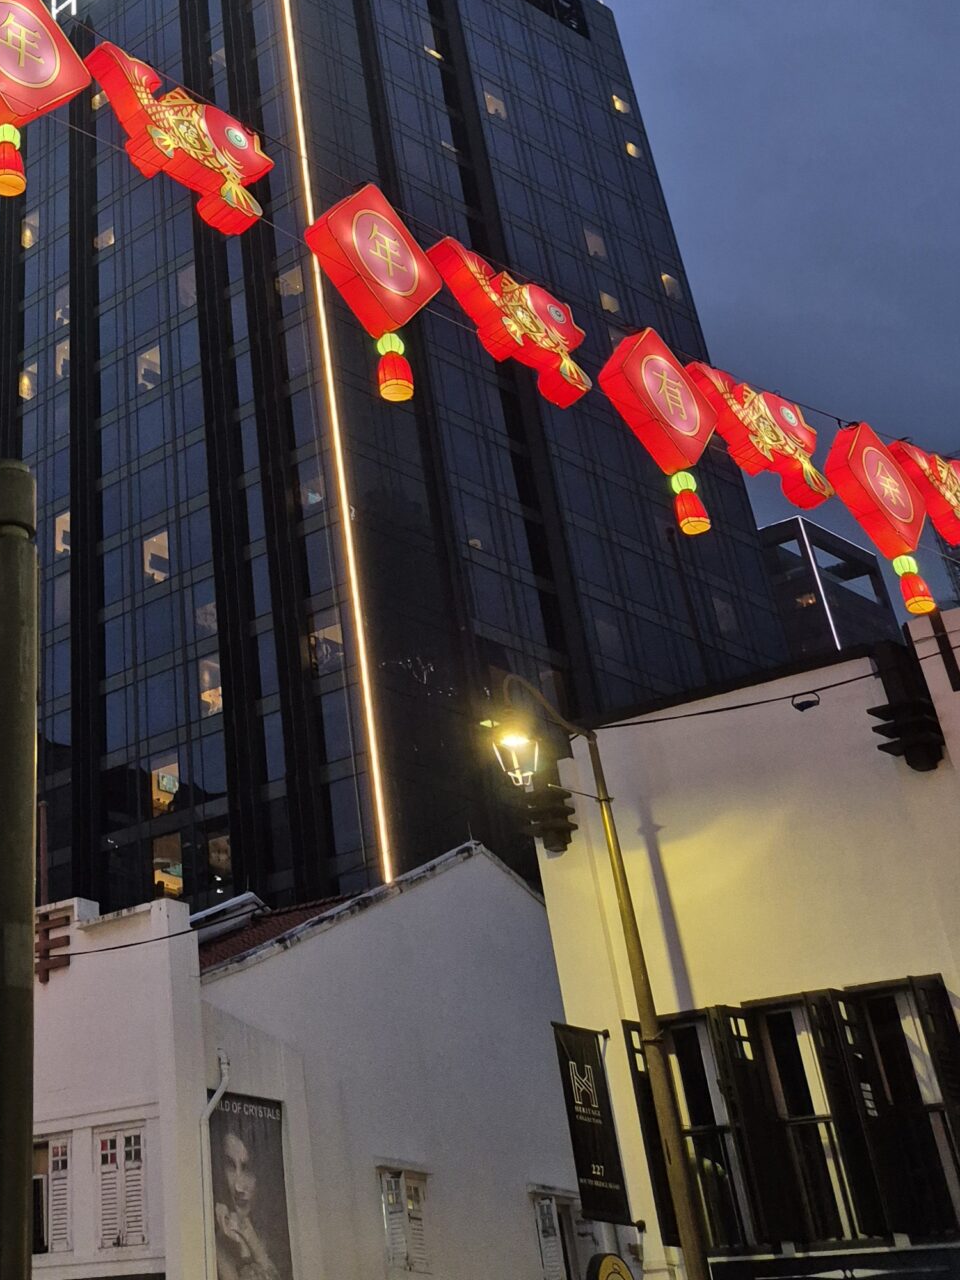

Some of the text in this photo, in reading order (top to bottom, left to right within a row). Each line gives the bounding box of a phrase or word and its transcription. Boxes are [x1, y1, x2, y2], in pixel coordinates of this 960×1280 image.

[367, 223, 408, 277] 年
[651, 369, 688, 421] 有
[243, 1104, 280, 1120] CRYSTALS
[591, 1163, 605, 1177] 227
